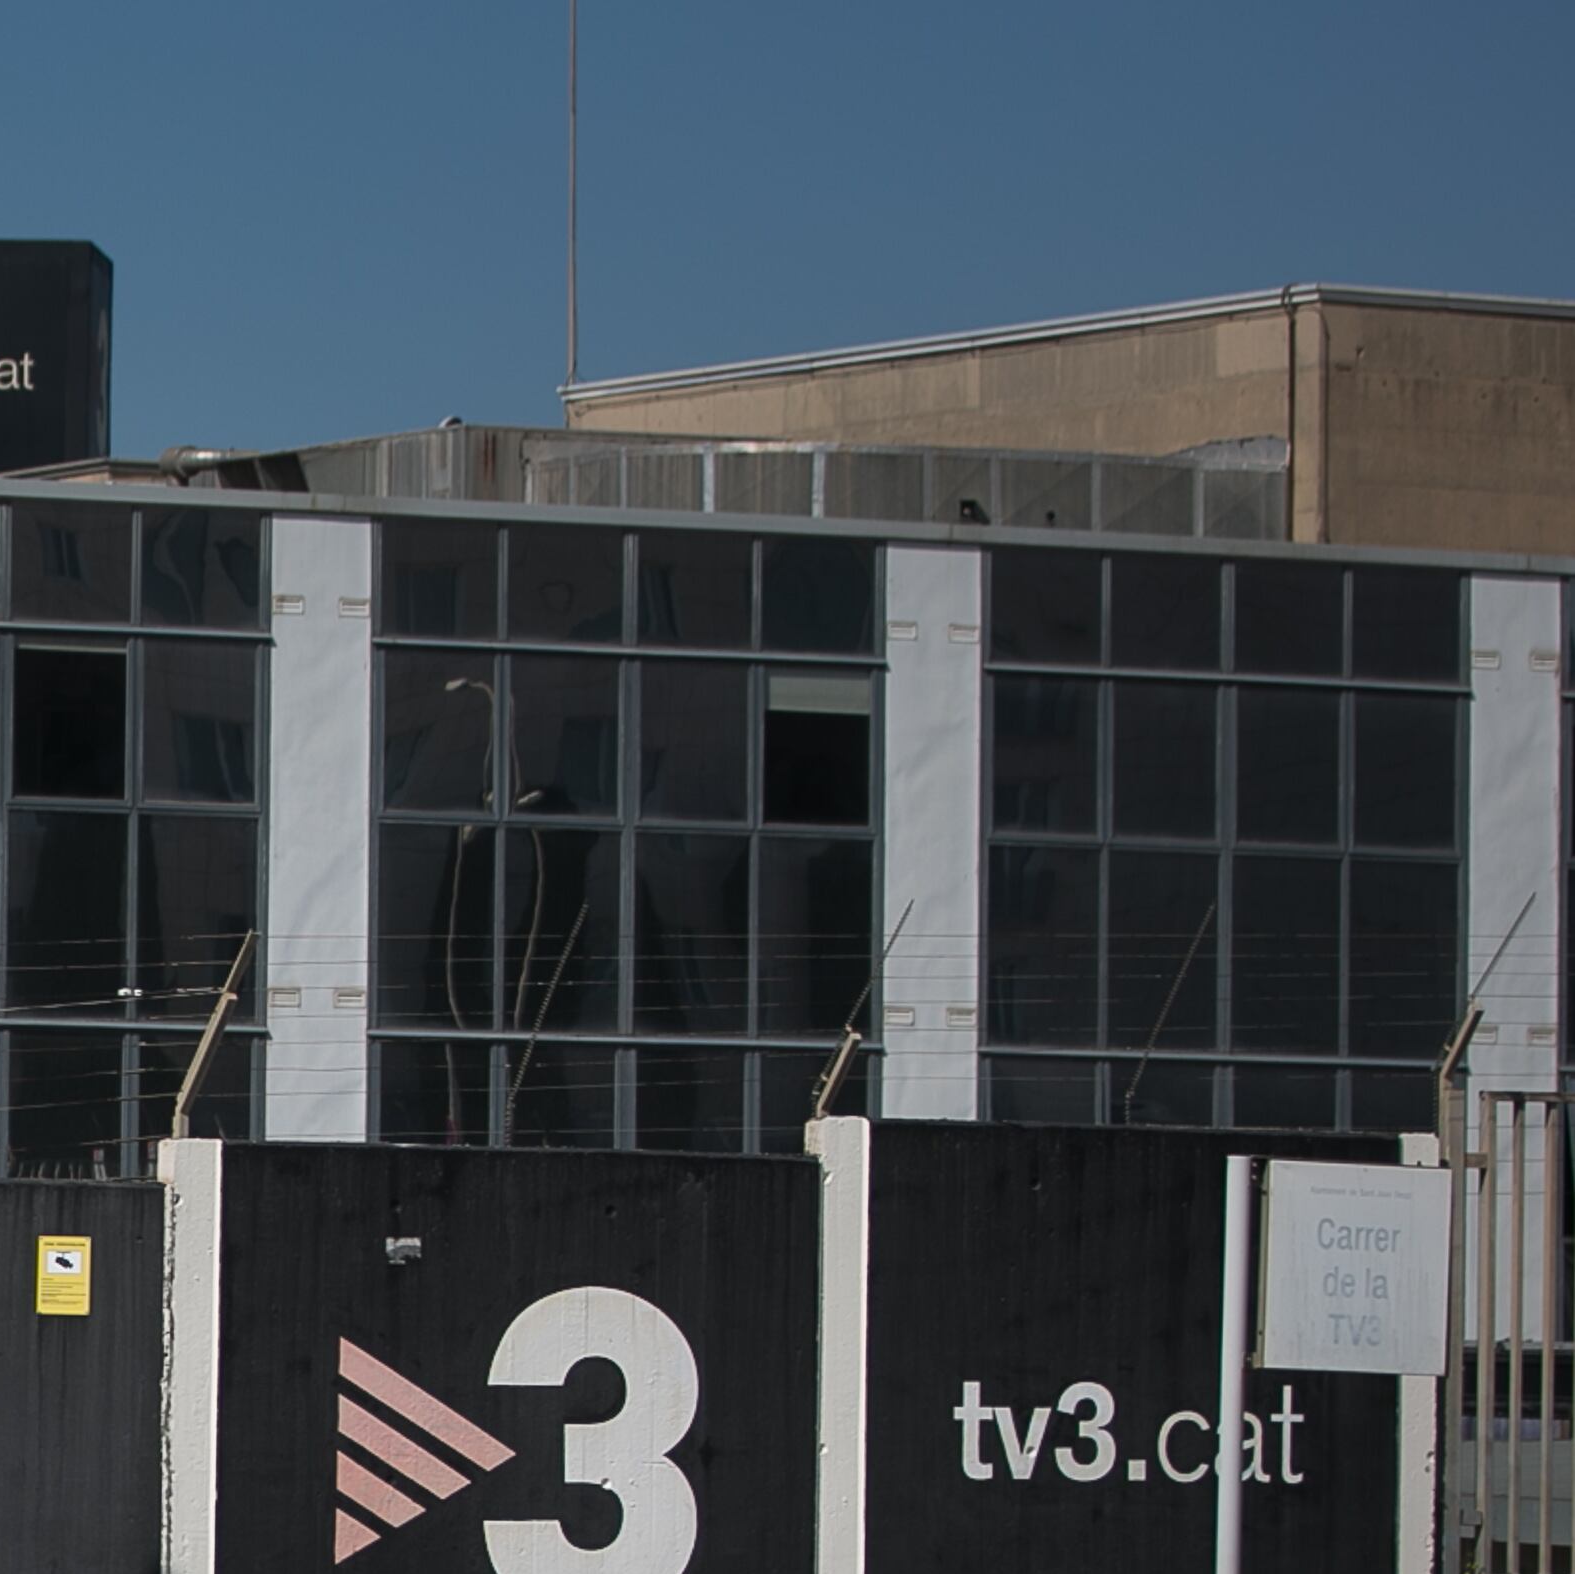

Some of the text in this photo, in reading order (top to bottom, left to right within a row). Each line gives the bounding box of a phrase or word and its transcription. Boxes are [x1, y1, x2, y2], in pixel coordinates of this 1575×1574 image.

[1317, 1217, 1401, 1253] Carrer
[1322, 1266, 1389, 1300] de la
[1327, 1313, 1382, 1347] TV3
[953, 1381, 1304, 1484] tv3.cat
